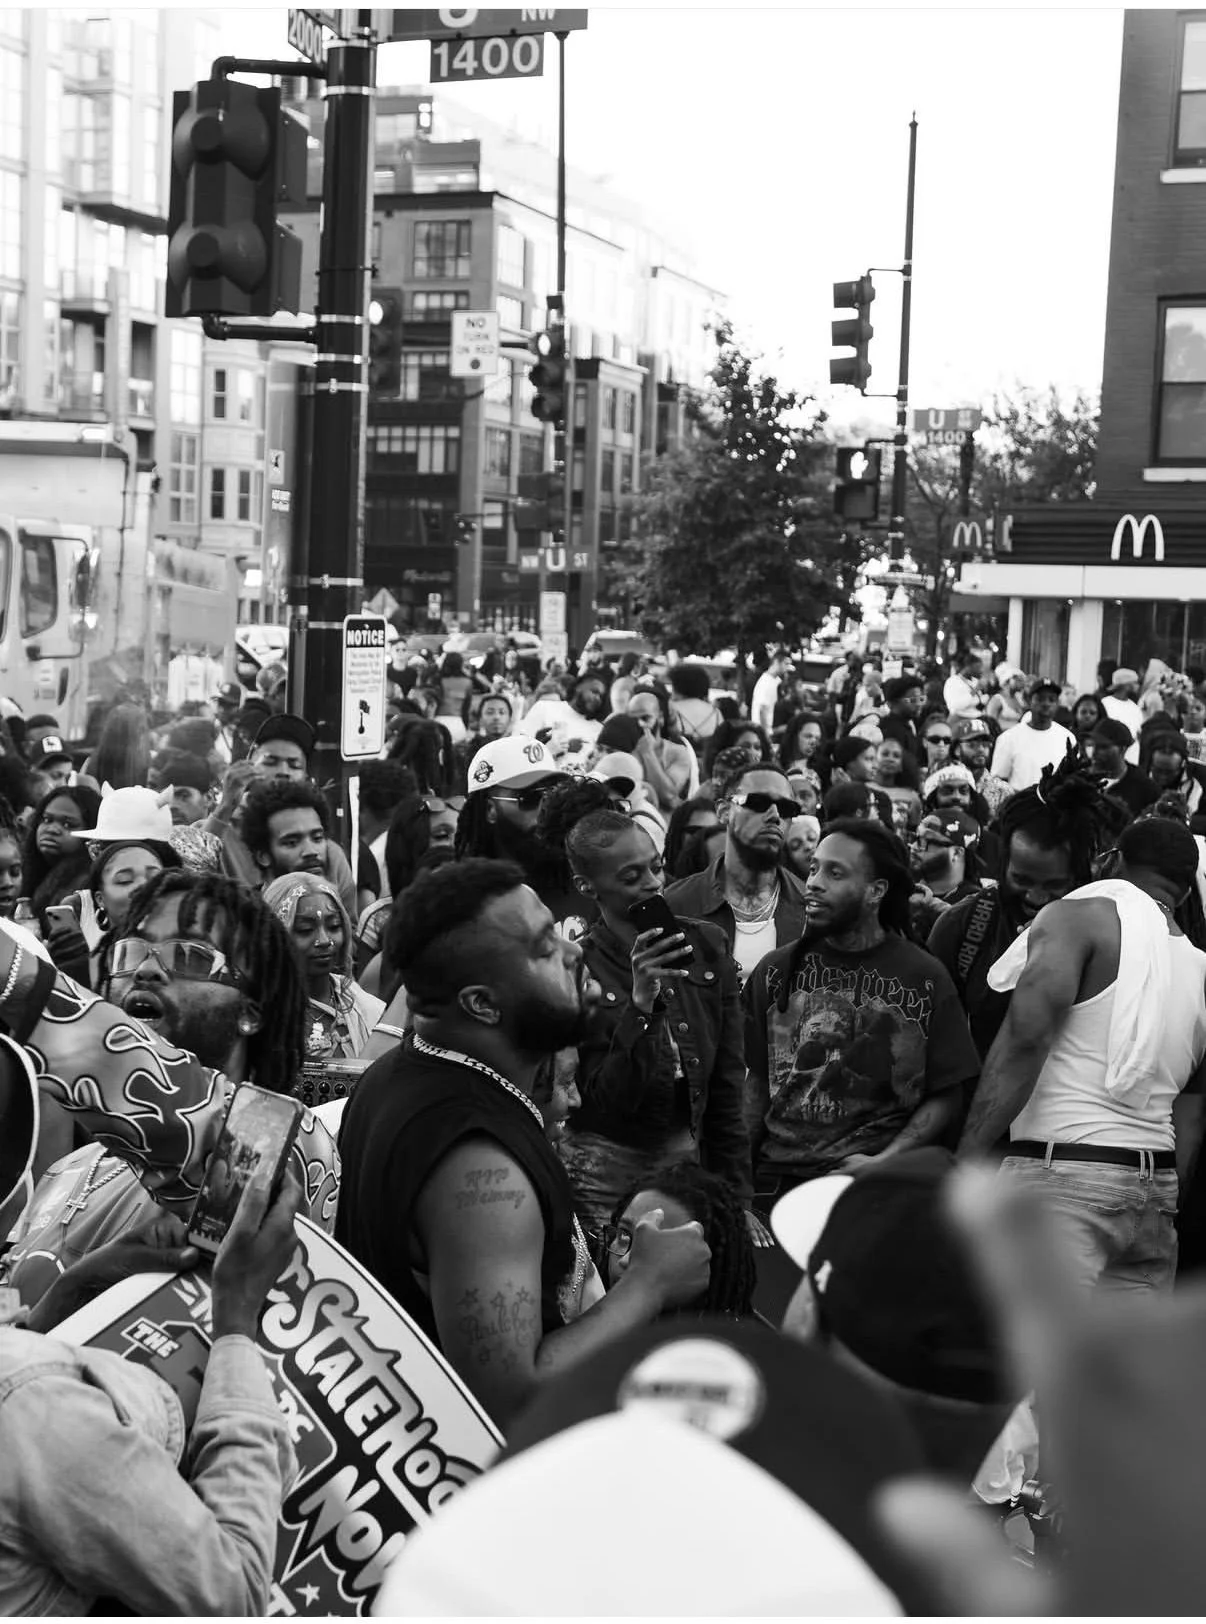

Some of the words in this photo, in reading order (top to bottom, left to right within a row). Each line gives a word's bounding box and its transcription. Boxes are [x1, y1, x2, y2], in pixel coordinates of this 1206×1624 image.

[433, 35, 540, 78] 1400
[466, 316, 487, 329] NO
[928, 409, 945, 430] U
[928, 430, 967, 444] 1400
[546, 548, 567, 572] U
[347, 629, 384, 646] NOTICE
[961, 898, 996, 943] HARD
[131, 1321, 181, 1360] THE
